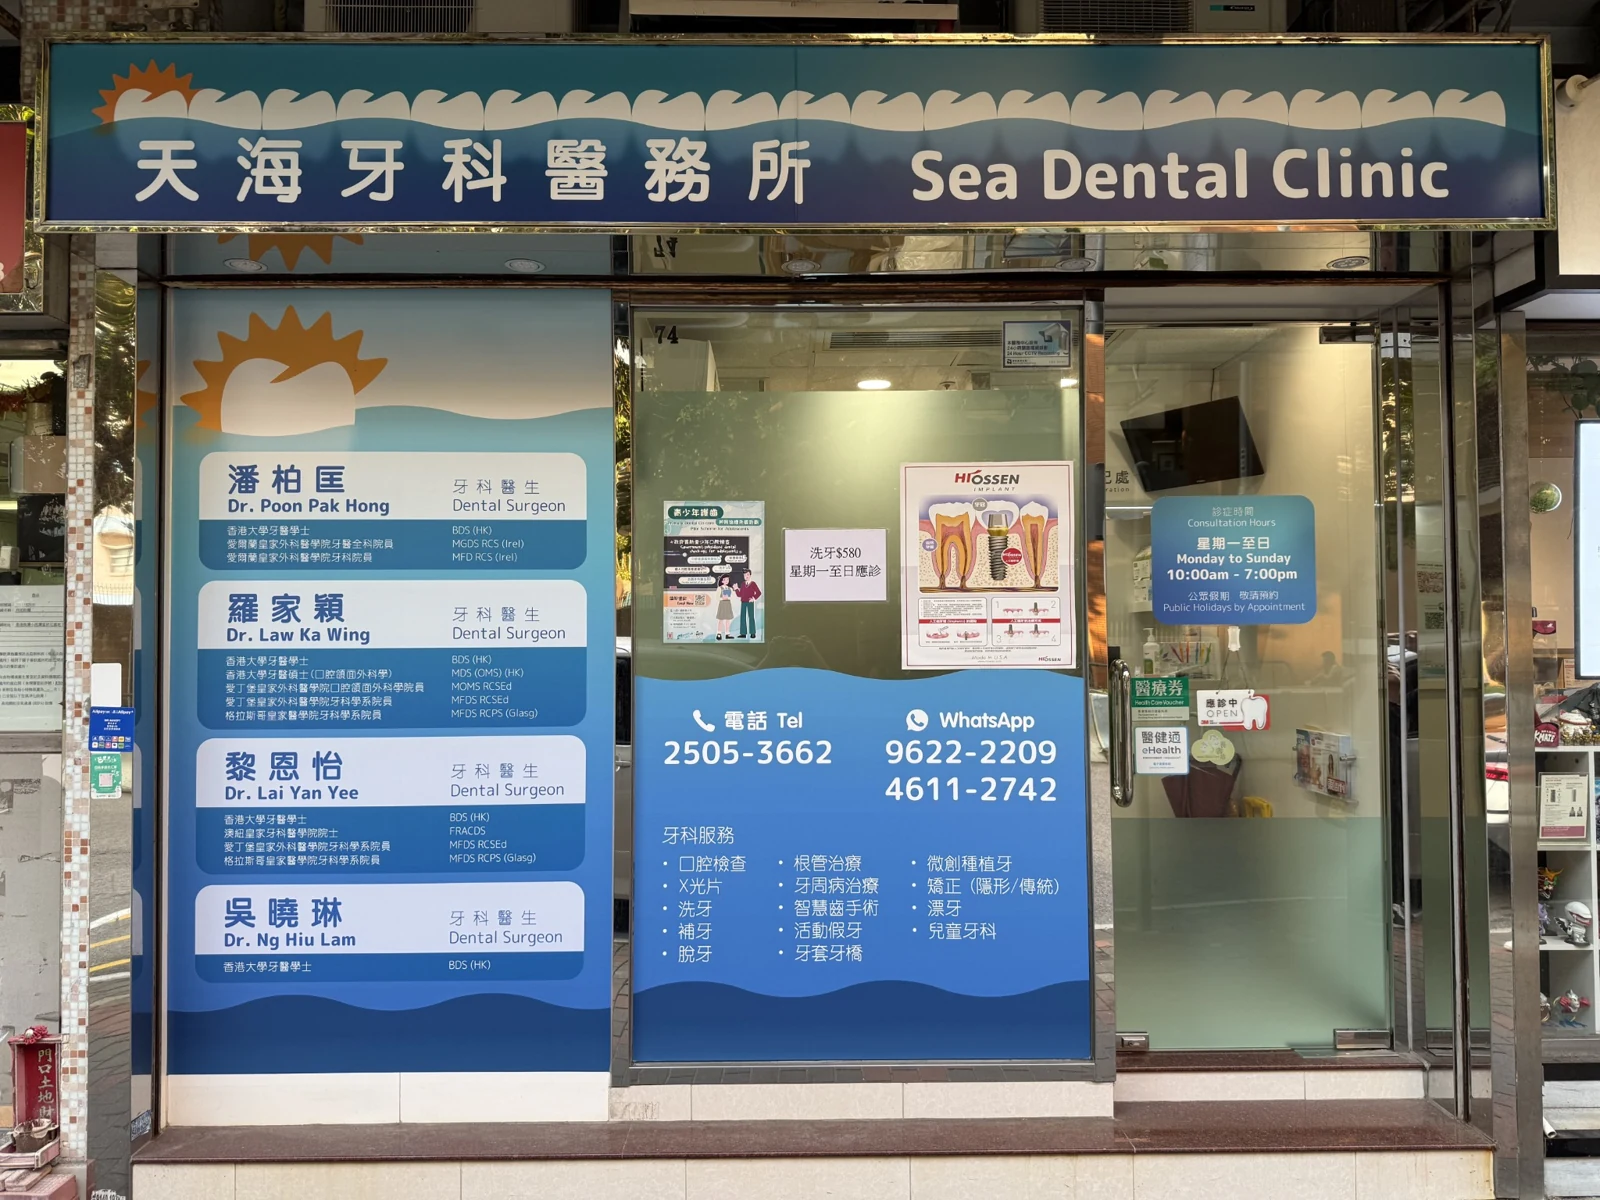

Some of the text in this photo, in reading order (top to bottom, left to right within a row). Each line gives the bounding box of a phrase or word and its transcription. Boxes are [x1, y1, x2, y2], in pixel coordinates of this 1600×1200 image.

[135, 137, 811, 204] 天海牙科醫務所
[912, 148, 1449, 201] Sea Dental Clinic
[655, 326, 679, 344] 74
[229, 464, 345, 494] 潘柏匡
[955, 470, 1019, 484] HIOSSEN
[453, 479, 539, 494] 牙科醫生
[228, 498, 389, 516] Dr. Poon Pak Hong
[453, 499, 565, 515] Dental Surgeon
[1212, 506, 1254, 517] 診症時間
[227, 525, 309, 535] 香港大學牙醫學士
[1187, 518, 1276, 528] Consultation Hours
[453, 526, 492, 535] BDS (HK)
[227, 539, 393, 549] 愛爾蘭皇家外科醫學院牙醫全科院員
[453, 539, 524, 548] MGDS RCS (Irel)
[1197, 536, 1270, 550] 星期一至日
[227, 553, 372, 563] 愛爾蘭皇家外科醫學院牙科院員
[453, 553, 517, 562] MFD RCS (Irel)
[810, 547, 861, 559] 洗牙$580
[1177, 553, 1291, 566] Monday to Sunday
[790, 565, 881, 577] 星期一至日應診
[1167, 569, 1229, 581] 10:00am
[1244, 569, 1298, 582] 7:00pm
[1188, 590, 1279, 601] 公眾假期 敬請預約
[228, 593, 344, 623] 羅家穎
[453, 607, 539, 622] 牙科醫生
[1163, 602, 1306, 613] Public Holidays by Appointment
[227, 627, 369, 645] Dr. Law Ka Wing
[453, 627, 565, 642] Dental Surgeon
[996, 635, 1002, 643] 3
[1051, 635, 1057, 643] 4
[226, 656, 308, 666] 香港大學牙醫學士
[452, 655, 491, 664] BDS (HK)
[452, 668, 523, 678] MDS (OMS) (HK)
[452, 682, 511, 691] MOMS RCSEd
[1135, 680, 1183, 697] 醫療券
[226, 696, 392, 707] 愛丁堡皇家外科醫學院牙科學系院員
[452, 695, 508, 704] MFDS RCSEd
[1206, 698, 1237, 708] 應診中
[226, 710, 381, 720] 格拉斯哥皇家醫學院牙科學系院員
[452, 708, 538, 719] MFDS RCPS (Glasg)
[725, 711, 802, 730] 電話 Tel
[1206, 709, 1238, 718] OPEN
[940, 711, 1034, 732] WhatsApp
[1141, 731, 1182, 744] 醫健通
[664, 740, 831, 764] 2505-3662
[886, 740, 1056, 764] 9622-2209
[1141, 746, 1182, 755] eHealth
[226, 751, 342, 781] 黎恩怡
[451, 763, 538, 779] 牙科醫生
[226, 786, 358, 800] Dr. Lai Yan Yee
[451, 783, 564, 799] Dental Surgeon
[885, 777, 1056, 801] 4611-2742
[224, 815, 306, 825] 香港大學牙醫學士
[450, 813, 489, 822] BDS (HK)
[224, 828, 338, 838] 澳紐皇家牙科醫學院院士
[450, 826, 485, 835] FRACDS
[663, 827, 734, 844] 牙科服務
[224, 841, 390, 852] 愛丁堡皇家外科醫學院牙科學系院員
[450, 840, 507, 849] MFDS RCSEd
[224, 855, 380, 866] 格拉斯哥皇家醫學院牙科學系院員
[450, 853, 536, 864] MFDS RCPS (Glasg)
[680, 856, 746, 872] 口腔檢查
[794, 855, 861, 871] 根管治療
[927, 855, 1012, 872] 微創種植牙
[680, 878, 722, 894] X光片
[795, 877, 879, 894] 牙周病治療
[928, 877, 961, 894] 矯正
[225, 897, 342, 928] 吳曉琳
[679, 901, 712, 917] 洗牙
[795, 899, 879, 916] 智慧齒手術
[928, 900, 961, 916] 漂牙
[450, 910, 536, 926] 牙科醫生
[678, 923, 712, 940] 補牙
[794, 922, 862, 939] 活動假牙
[929, 922, 996, 939] 兒童牙科
[225, 932, 356, 951] Dr. Ng Hiu Lam
[450, 931, 562, 946] Dental Surgeon
[678, 946, 712, 962] 脫牙
[795, 945, 863, 962] 牙套牙橋
[224, 961, 311, 972] 香港大學牙醫學士
[449, 960, 490, 970] BDS (HK)
